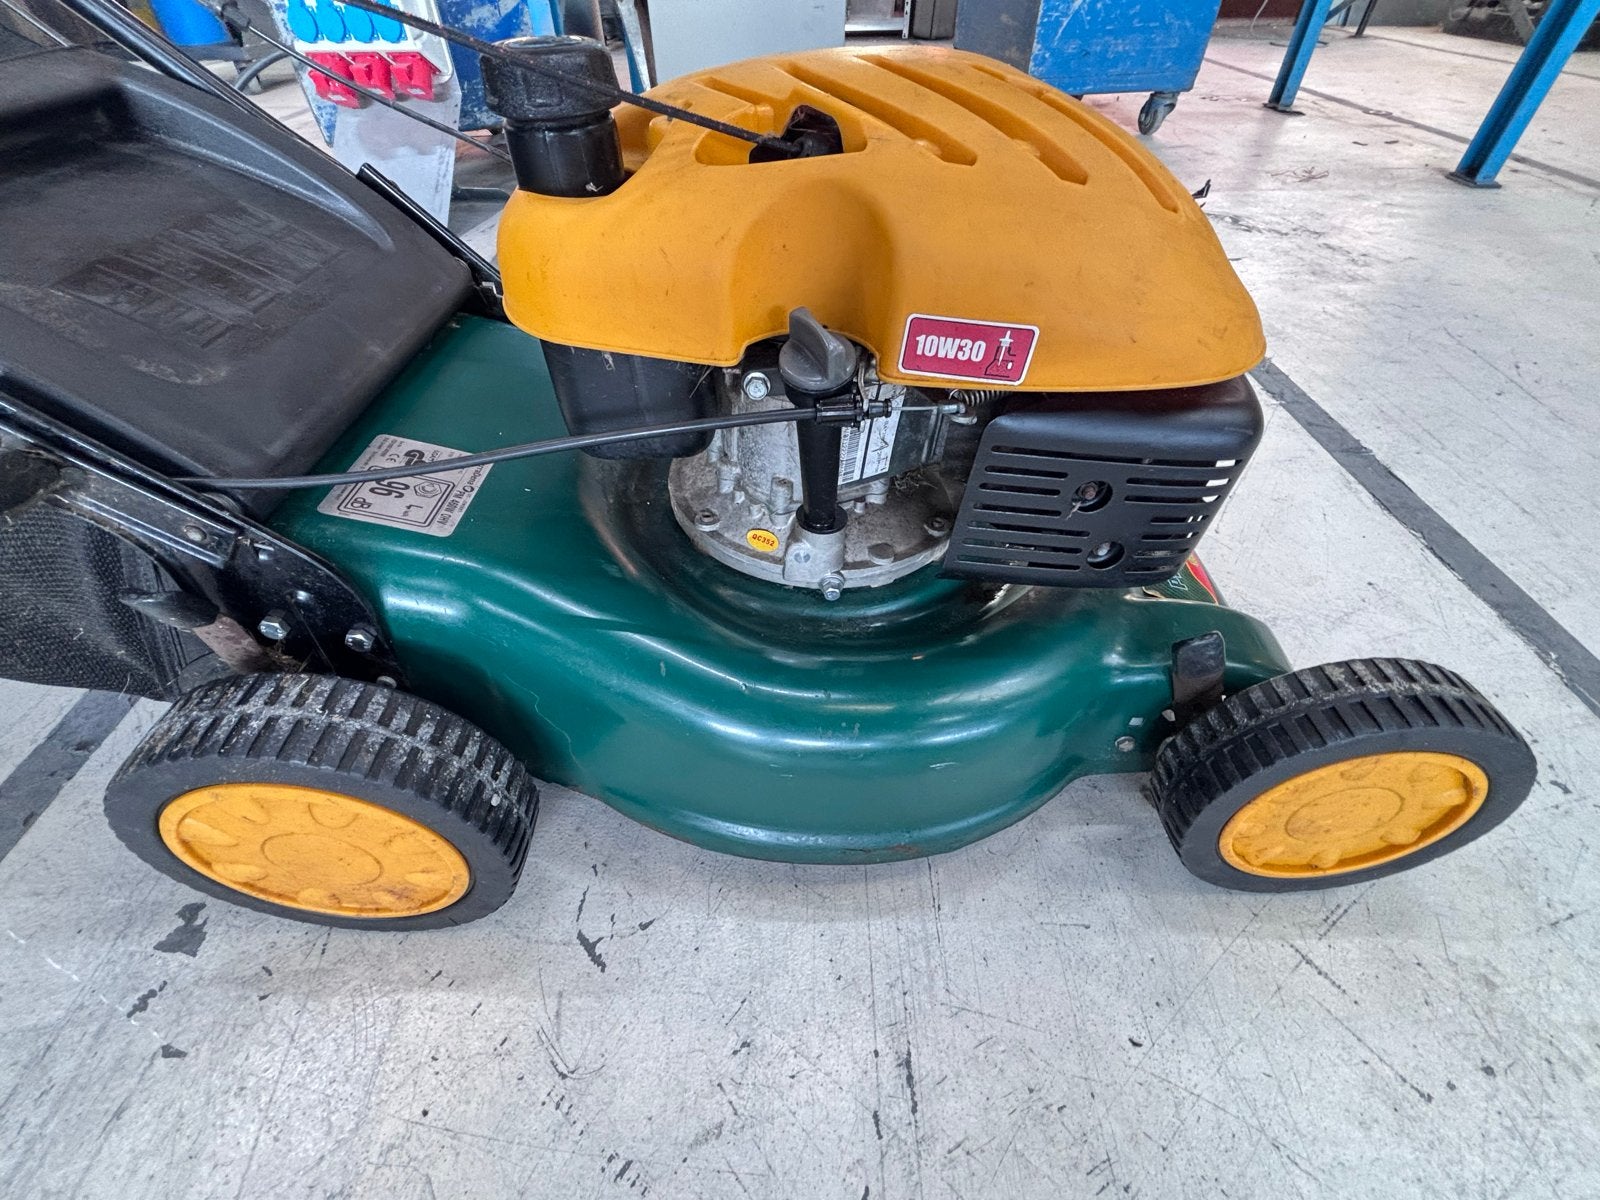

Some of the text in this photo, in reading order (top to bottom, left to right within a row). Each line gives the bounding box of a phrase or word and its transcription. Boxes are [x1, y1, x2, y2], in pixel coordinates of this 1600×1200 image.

[915, 334, 986, 361] 10W30
[369, 480, 411, 499] 96
[350, 497, 372, 510] dB
[752, 533, 775, 547] QC352
